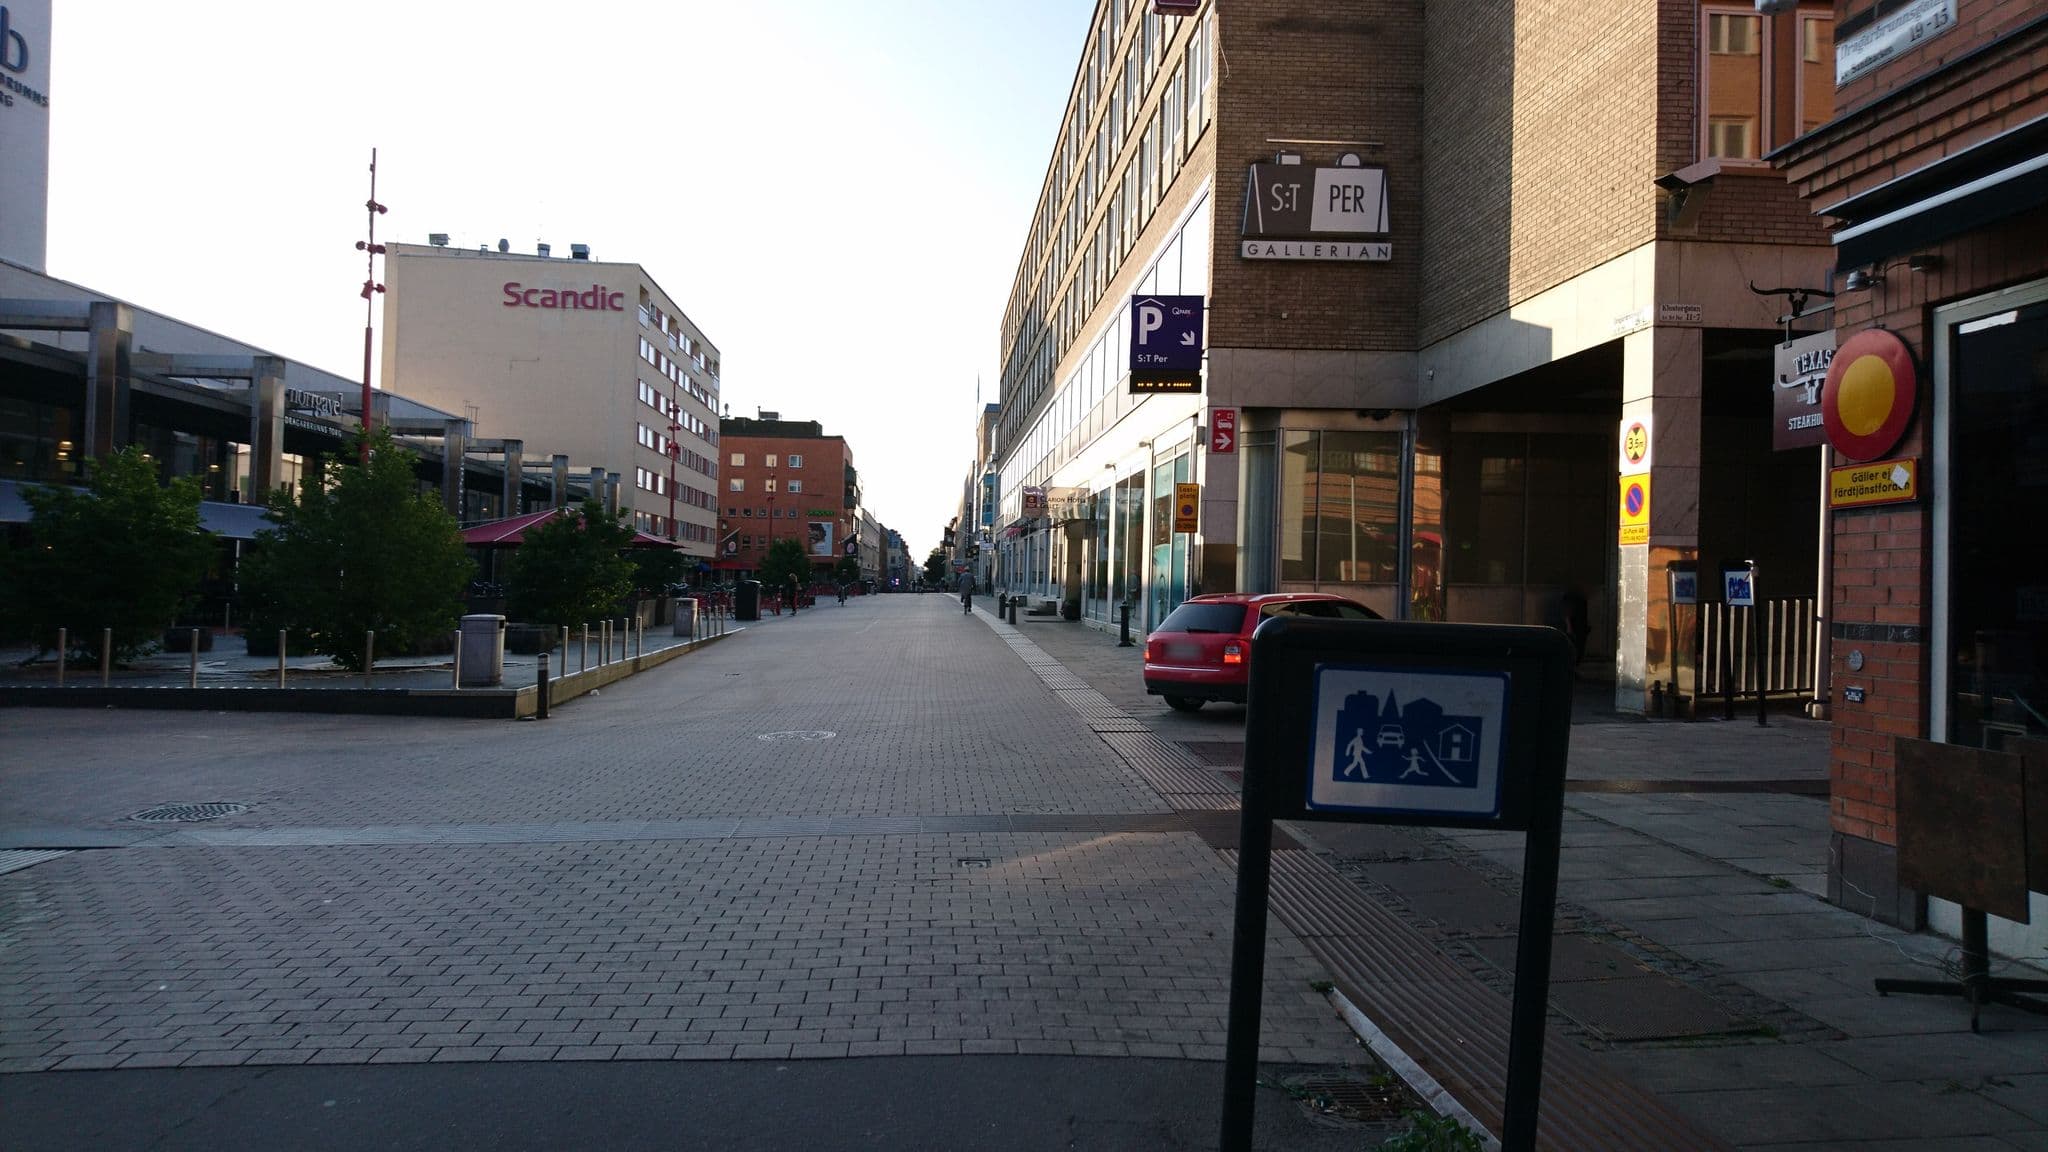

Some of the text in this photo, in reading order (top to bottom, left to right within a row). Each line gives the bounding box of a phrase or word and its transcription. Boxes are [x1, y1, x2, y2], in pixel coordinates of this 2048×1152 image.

[1271, 183, 1365, 213] S:T PER
[1247, 243, 1388, 258] GALLERIAN
[503, 281, 625, 312] Scandic
[1138, 306, 1163, 345] P
[1153, 354, 1169, 363] Per
[1793, 349, 1832, 376] TEXAS
[1851, 471, 1881, 483] Gäller
